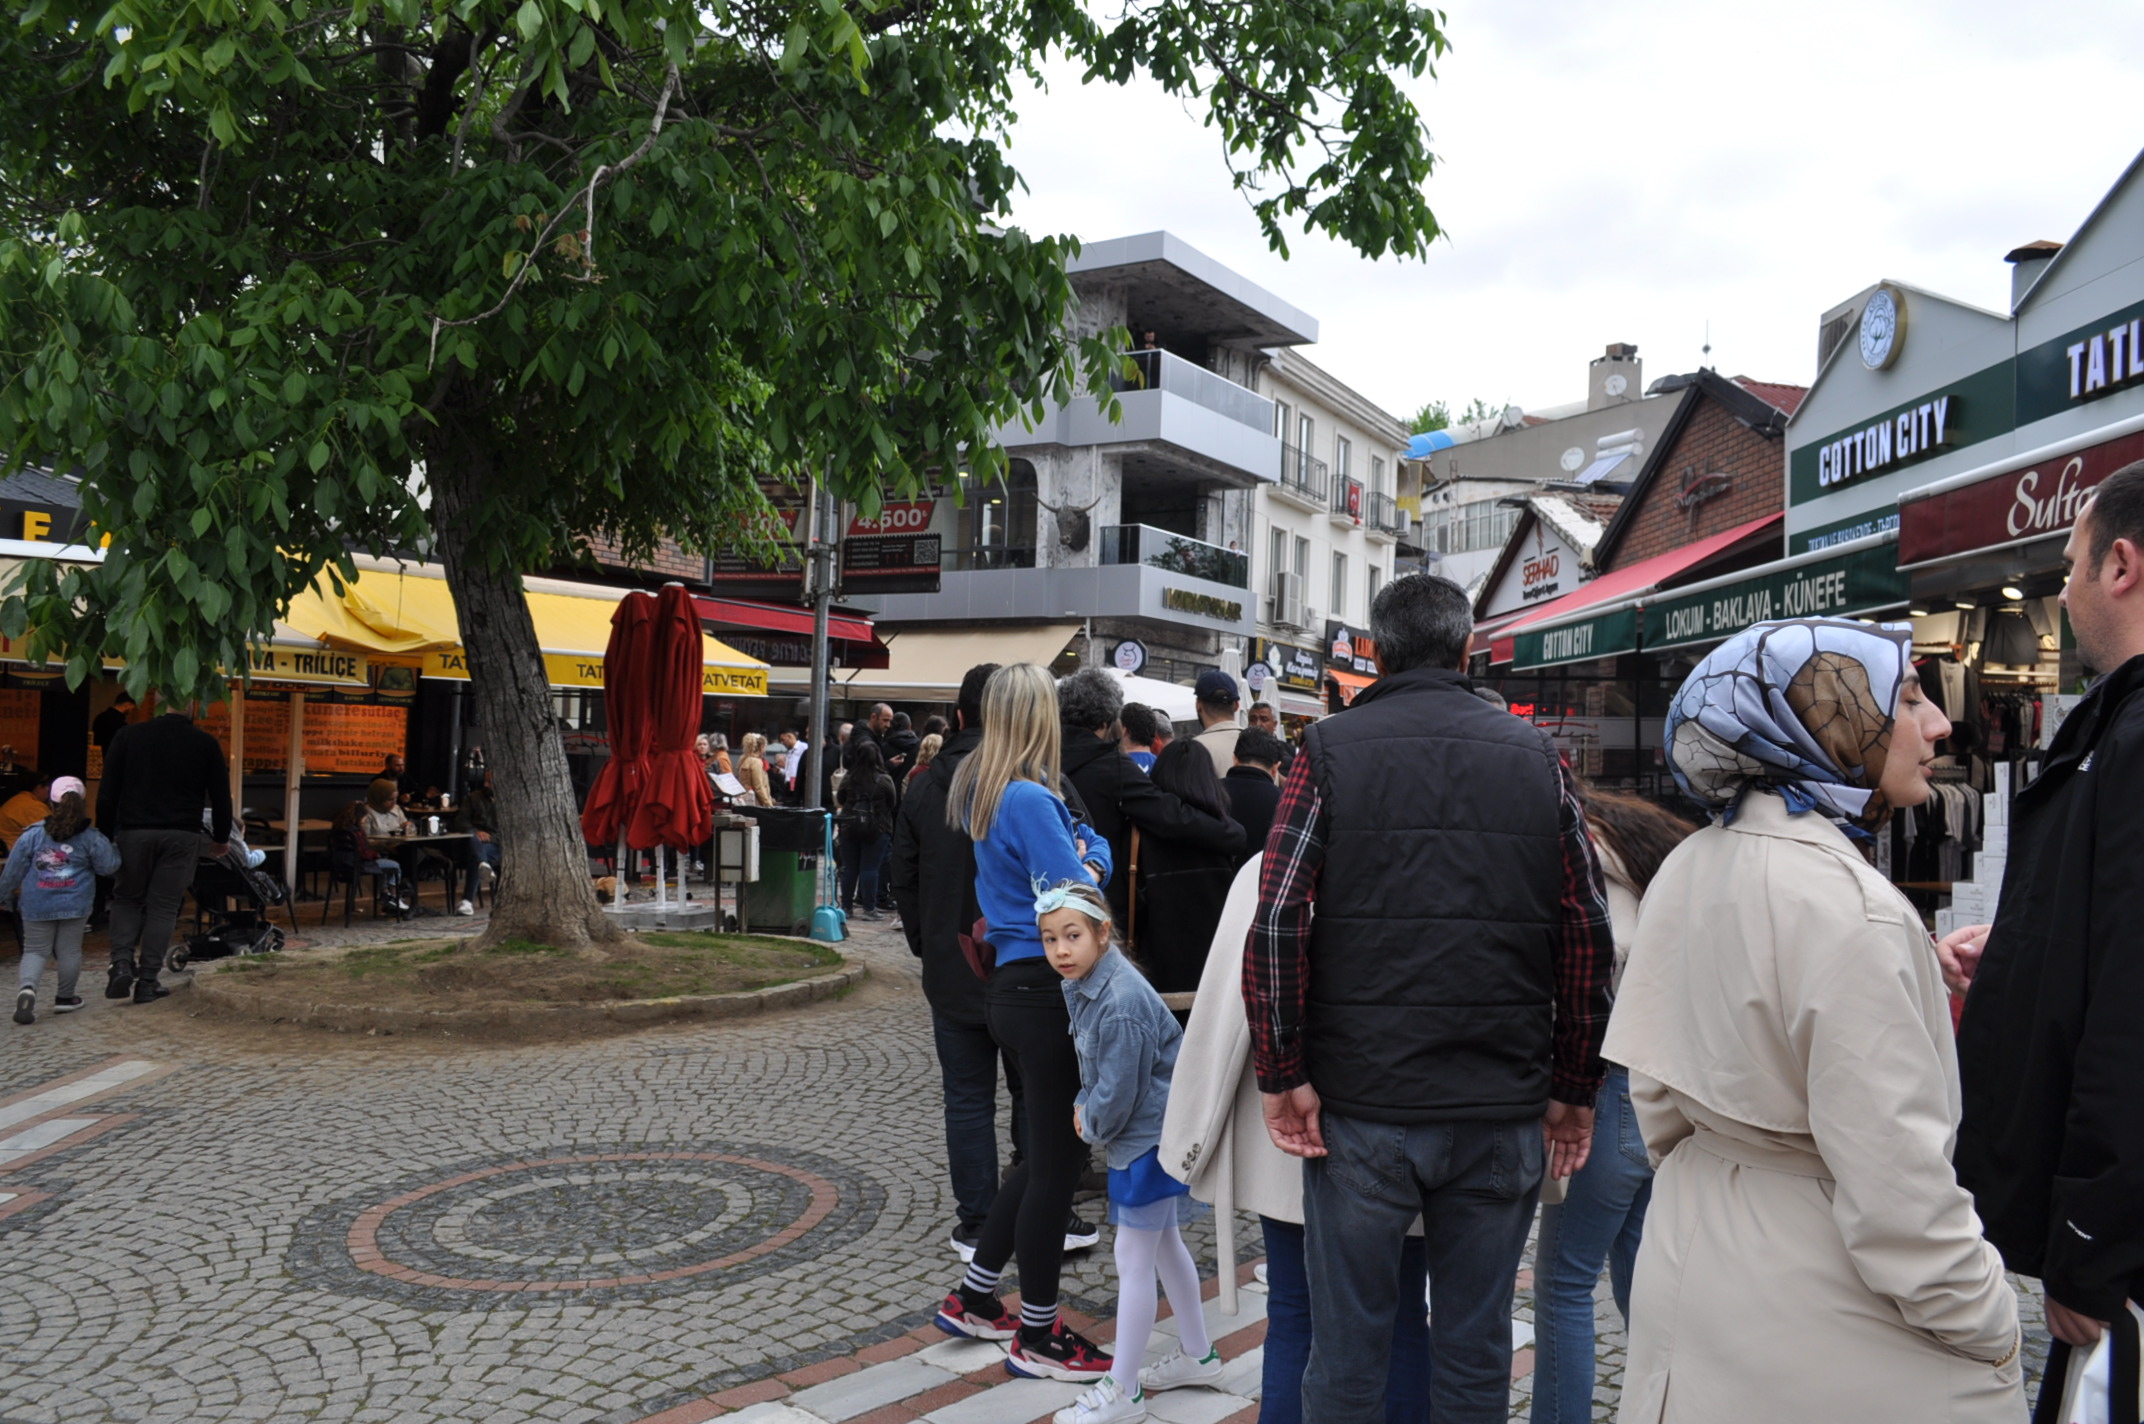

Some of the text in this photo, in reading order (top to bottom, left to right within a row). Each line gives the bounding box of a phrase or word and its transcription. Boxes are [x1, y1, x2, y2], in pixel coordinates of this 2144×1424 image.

[1819, 396, 1950, 487] COTTON CITY
[1522, 555, 1560, 586] SERHAD
[1666, 605, 1704, 640] LOKUM
[1713, 590, 1772, 631] BAKLAVA
[1784, 571, 1846, 616] KÜNEFE
[1543, 623, 1594, 661] COTTON CITY
[294, 650, 357, 678] TRİLİÇE
